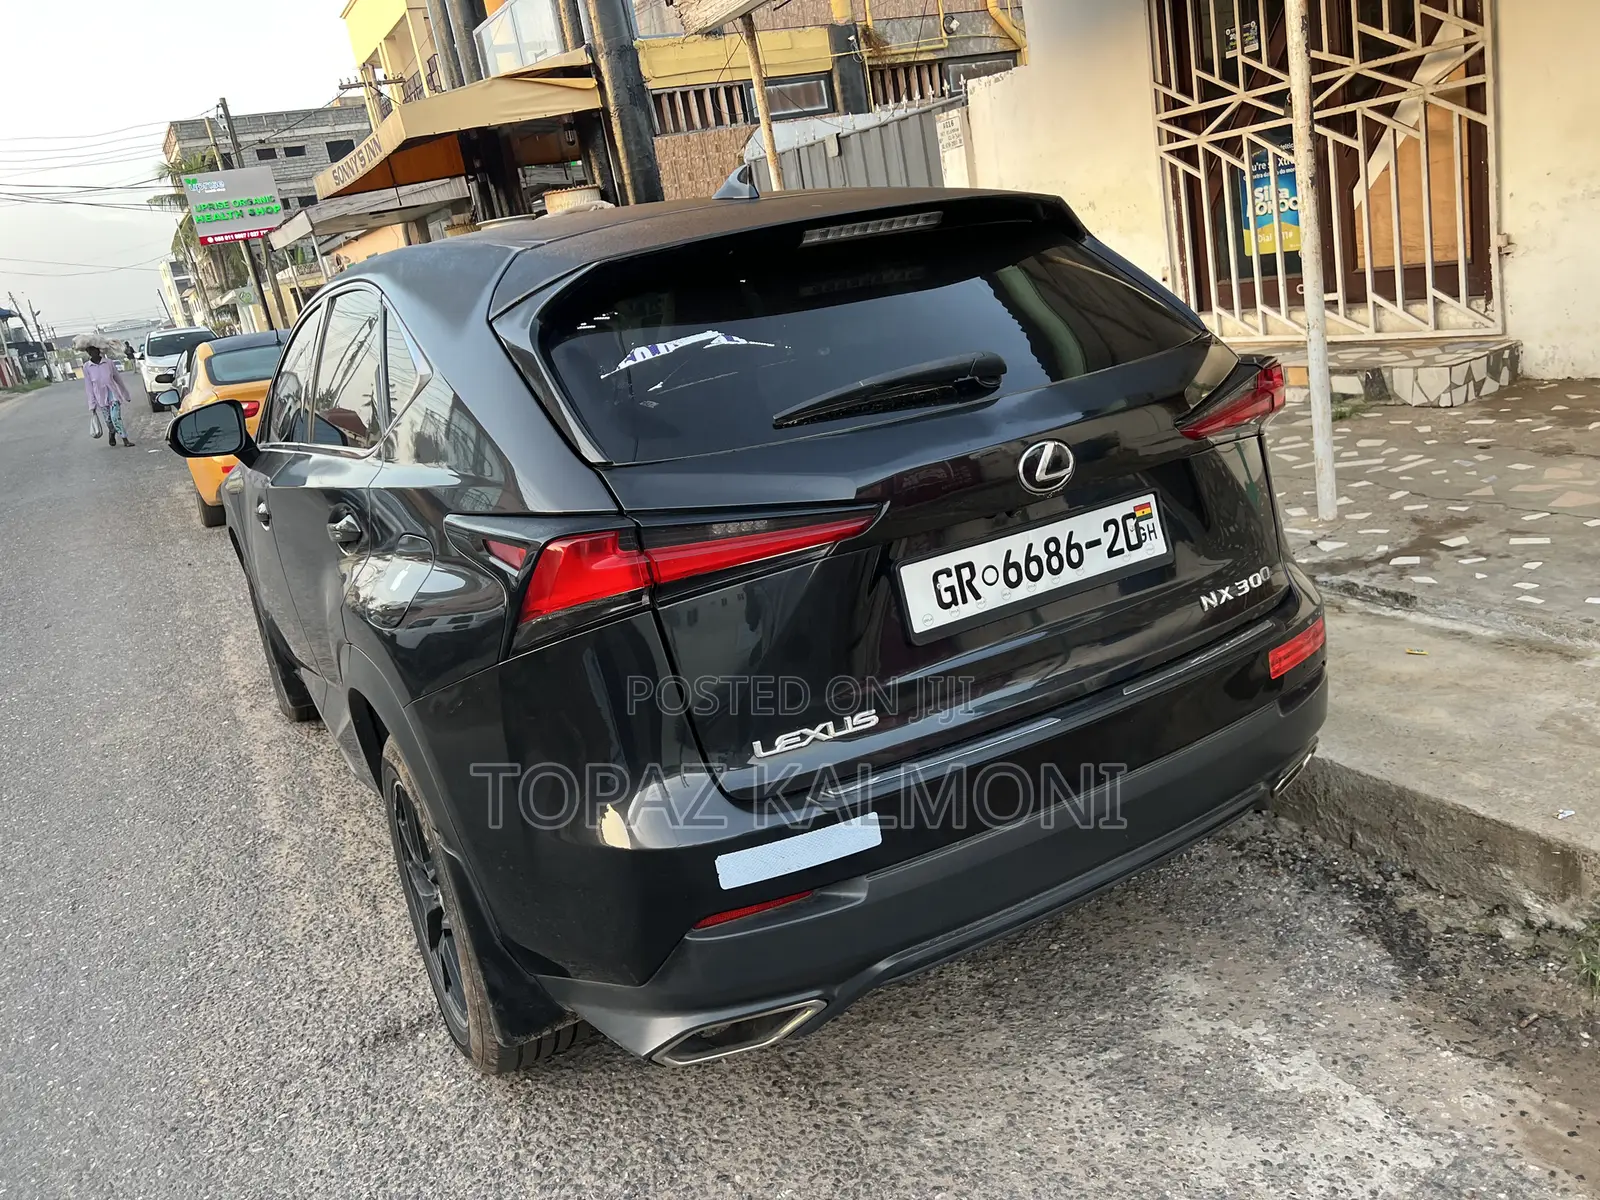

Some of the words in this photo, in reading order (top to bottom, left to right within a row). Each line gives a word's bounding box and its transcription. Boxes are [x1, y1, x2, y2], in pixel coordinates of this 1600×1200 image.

[332, 149, 367, 187] SONNY'S
[364, 133, 383, 164] INN
[194, 199, 230, 213] UPRISE
[231, 195, 276, 208] ORGANIC
[1254, 185, 1290, 202] Sia
[194, 209, 245, 224] HEALTH
[247, 204, 281, 217] SHOP
[1139, 522, 1158, 544] GH
[932, 560, 982, 610] GR
[1200, 585, 1234, 612] NX
[1234, 565, 1271, 597] 300
[752, 709, 880, 758] LEXUS
